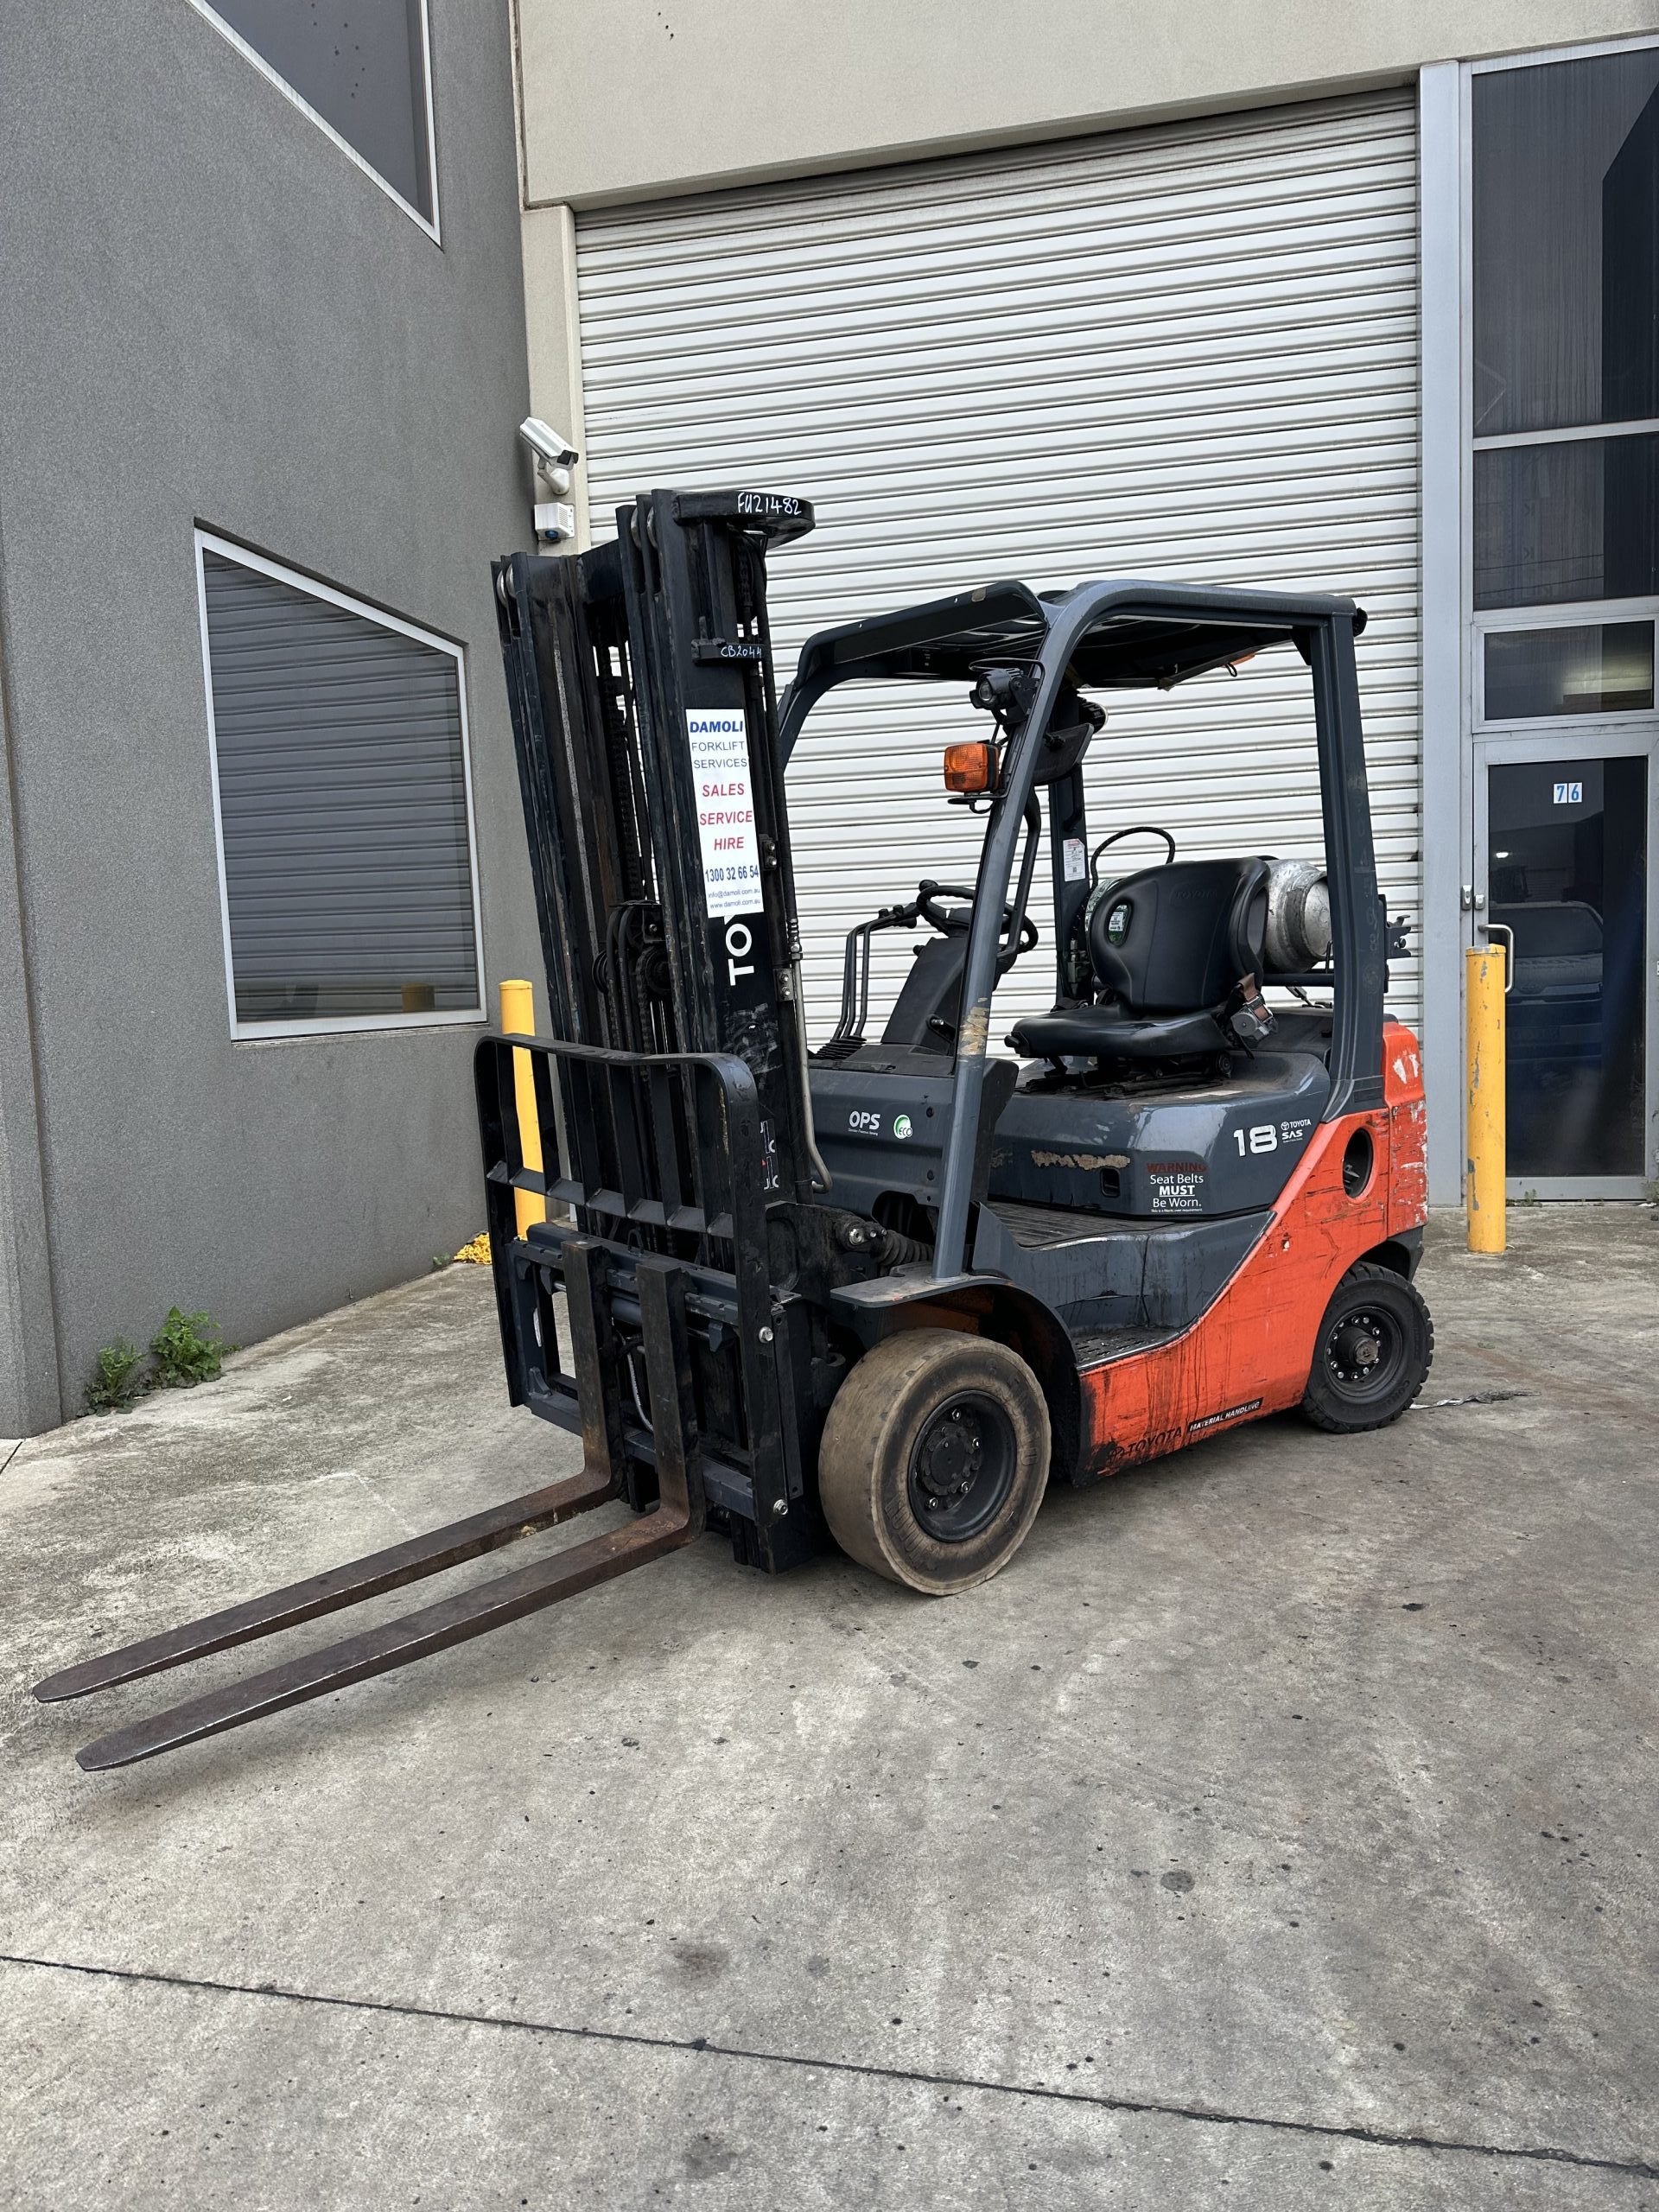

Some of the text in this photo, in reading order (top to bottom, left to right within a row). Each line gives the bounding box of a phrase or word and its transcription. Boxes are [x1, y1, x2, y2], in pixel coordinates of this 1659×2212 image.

[690, 721, 743, 733] DAMOLI
[691, 741, 745, 752] FORKLIFT
[693, 758, 747, 769] SERVICES
[702, 783, 745, 797] SALES
[1556, 784, 1580, 802] 76
[699, 810, 753, 825] SERVICE
[714, 836, 745, 850] HIRE
[705, 864, 759, 882] 1300 32 66 54
[849, 1110, 880, 1130] OPS
[1289, 1118, 1312, 1128] TOYOTA
[1233, 1124, 1278, 1157] 18
[1281, 1129, 1303, 1141] SAS
[1150, 1173, 1204, 1185] Seat Belts
[1159, 1185, 1195, 1197] MUST
[1153, 1198, 1202, 1208] Be Worn.
[1189, 1414, 1224, 1432] MATERIAL
[1224, 1402, 1260, 1420] HANDLING
